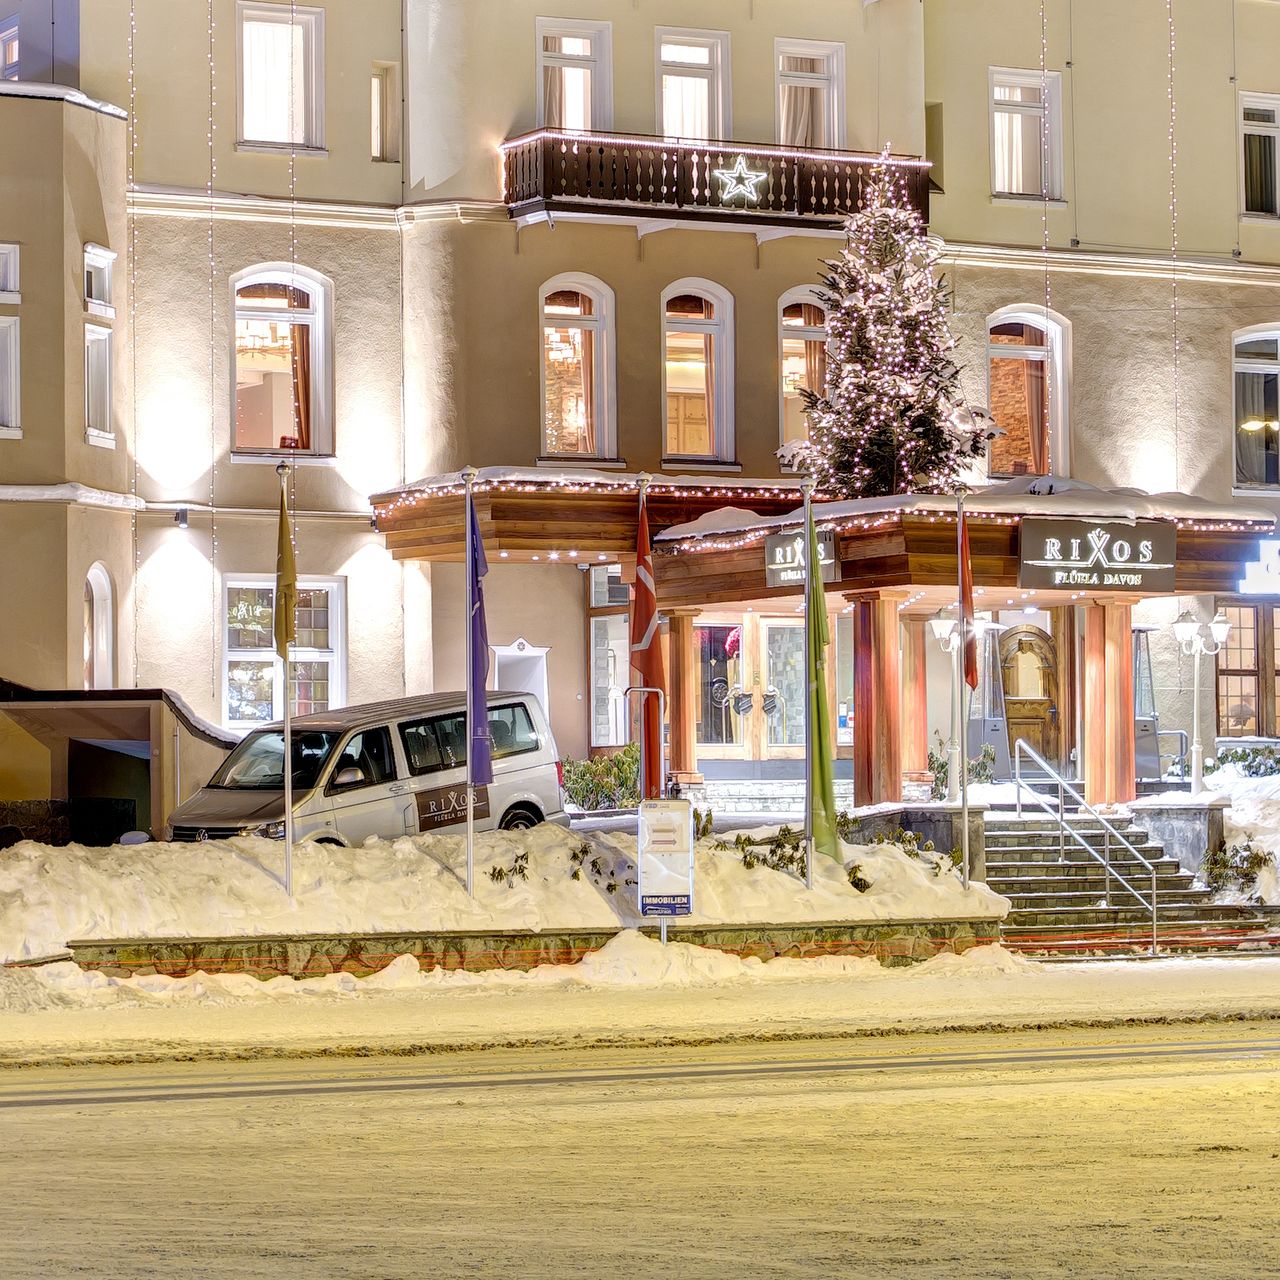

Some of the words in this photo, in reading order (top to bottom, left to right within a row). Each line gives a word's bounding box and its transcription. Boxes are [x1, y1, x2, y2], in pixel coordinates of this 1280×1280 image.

[774, 536, 825, 567] RIXS
[1044, 528, 1154, 568] RIXOS
[1103, 573, 1143, 586] DAVOS
[429, 790, 478, 812] RIXOS
[643, 896, 688, 904] IMMOBILIEN
